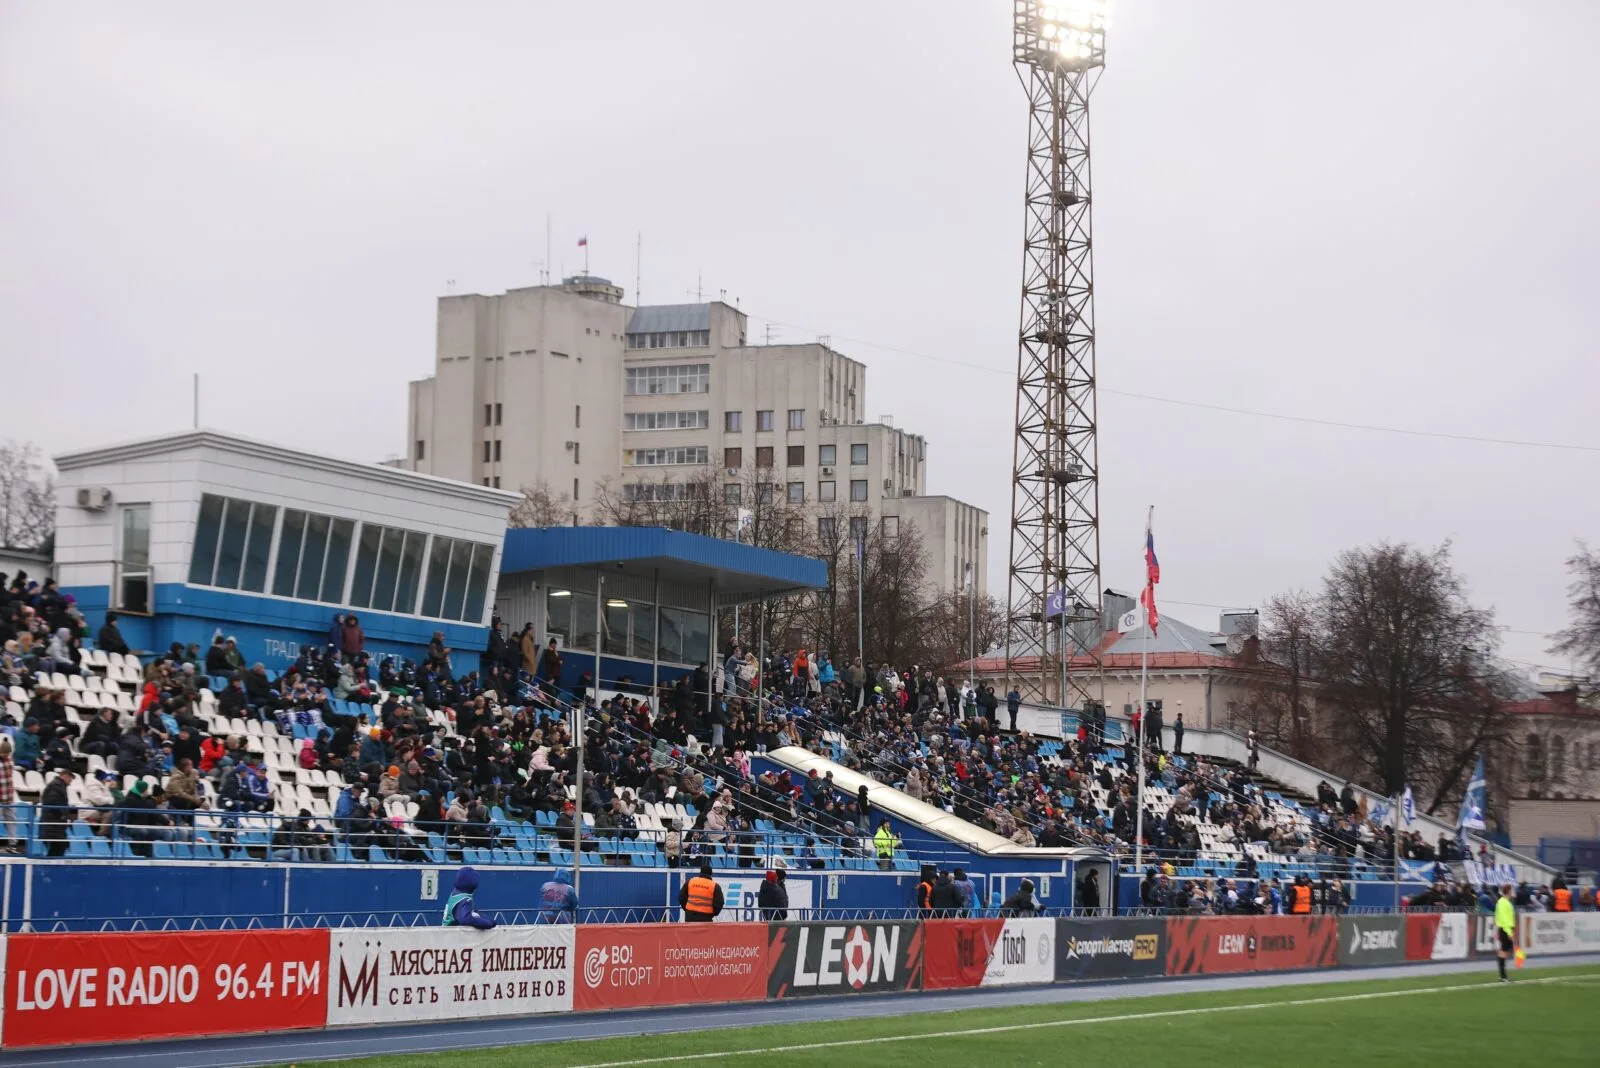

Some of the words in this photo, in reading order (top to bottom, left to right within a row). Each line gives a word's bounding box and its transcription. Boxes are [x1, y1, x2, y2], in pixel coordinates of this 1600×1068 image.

[389, 948, 472, 976] МЯСНАЯ
[481, 946, 567, 972] ИМПЕРИЯ
[611, 945, 632, 964] ВО!
[664, 945, 715, 960] СПОРТИВНЫЙ
[716, 946, 760, 960] МЕДИАОФИС
[793, 925, 899, 989] LEON
[610, 966, 653, 987] СПОРТ
[664, 962, 718, 978] ВОЛОГОДСКОЙ
[720, 963, 751, 975] ОБЛАСТИ
[16, 968, 97, 1010] LOVE
[106, 964, 199, 1006] RADIO
[215, 962, 274, 1000] 96.4
[281, 960, 320, 996] FM
[389, 986, 439, 1005] СЕТЬ
[454, 980, 566, 1002] МАГАЗИНОВ
